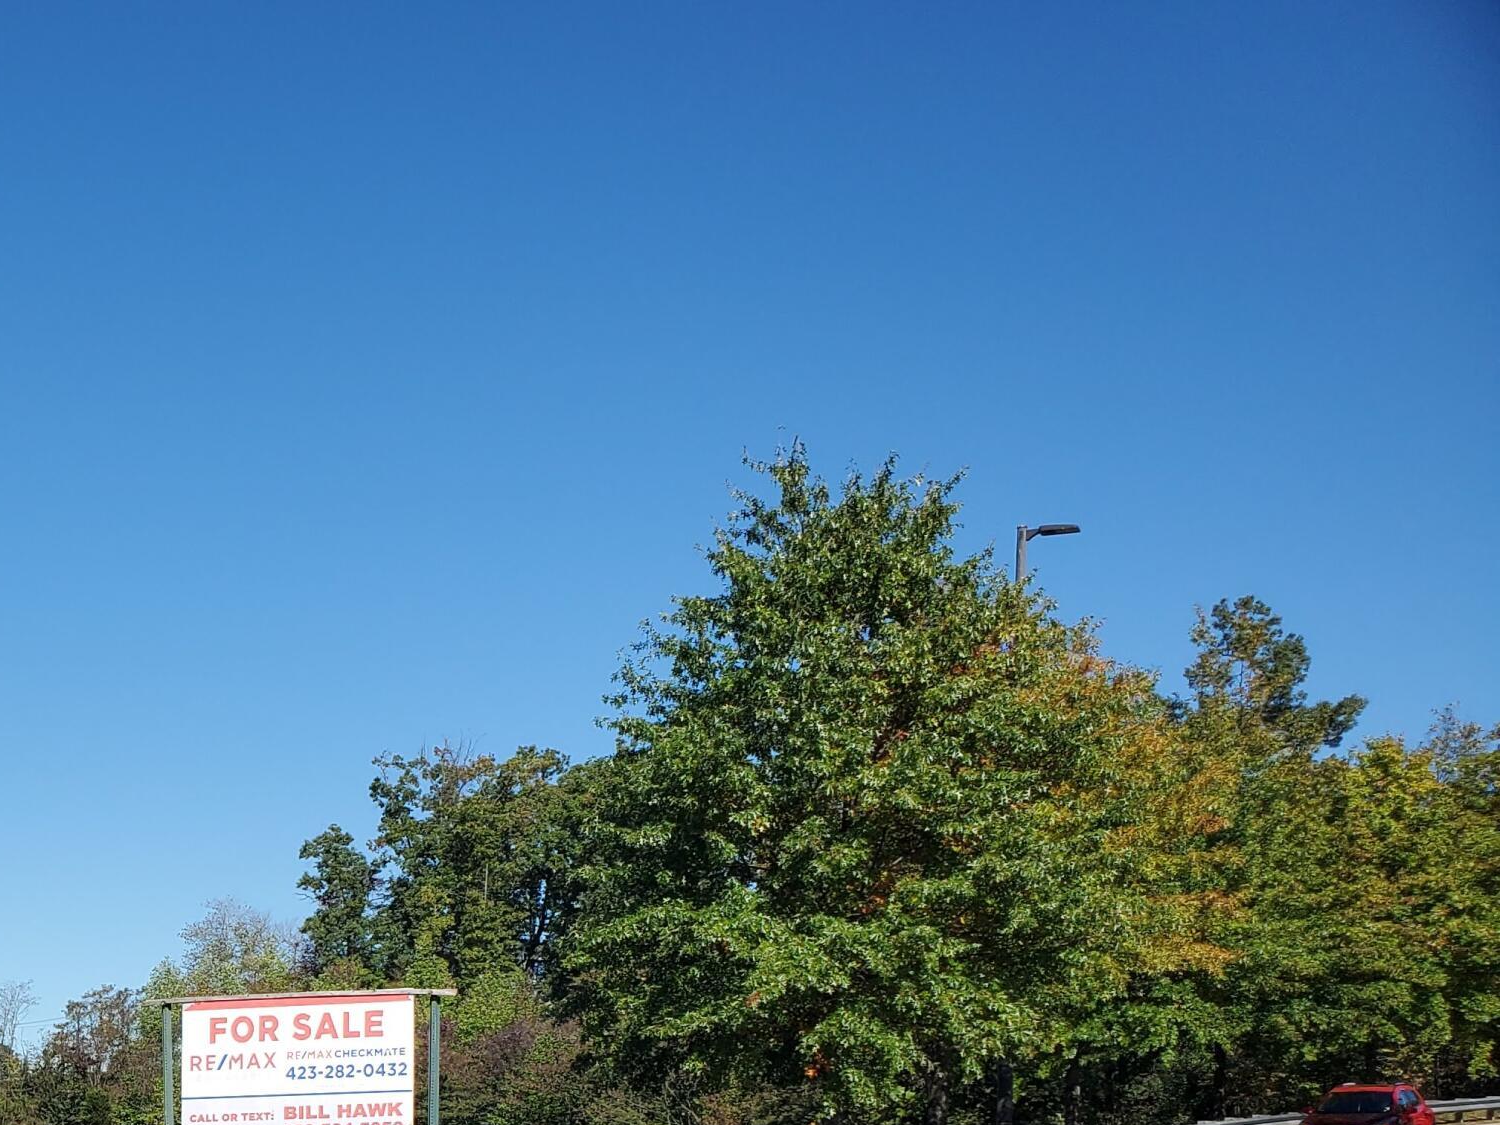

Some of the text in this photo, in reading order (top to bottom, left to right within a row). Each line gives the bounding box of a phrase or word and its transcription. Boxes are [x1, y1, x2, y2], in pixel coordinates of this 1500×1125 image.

[209, 1010, 384, 1044] FOR SALE
[189, 1052, 277, 1071] RE/MAX
[287, 1047, 406, 1060] RE/MAX CHECKMATE
[285, 1062, 408, 1080] 423-282-0432
[189, 1112, 275, 1123] CALL OR TEXT:
[283, 1102, 403, 1120] BILL HAWK
